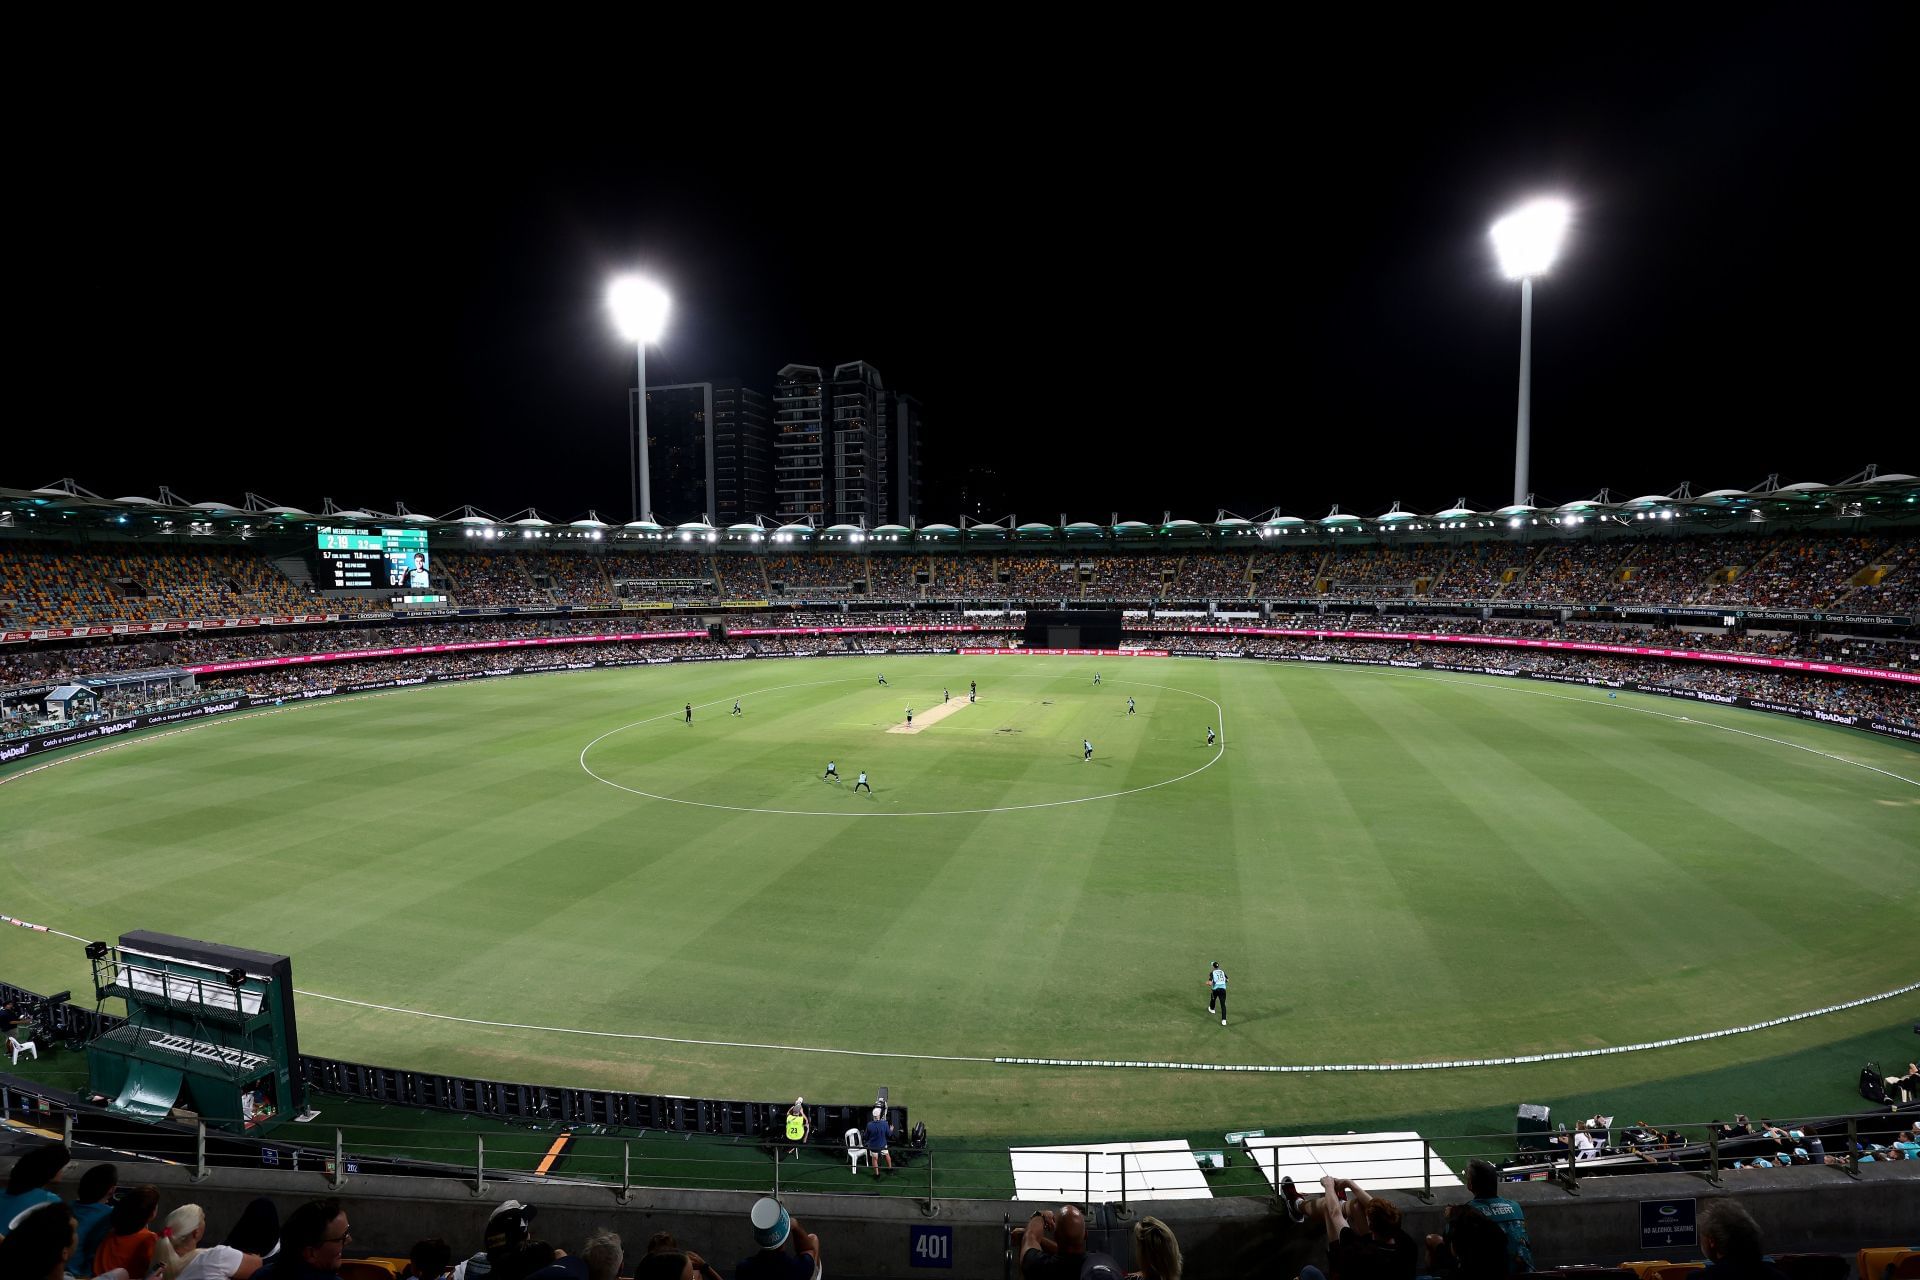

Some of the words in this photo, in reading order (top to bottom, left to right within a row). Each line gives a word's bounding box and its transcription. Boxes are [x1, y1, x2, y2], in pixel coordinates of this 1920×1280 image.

[1485, 667, 1514, 676] TripADeal
[396, 678, 423, 686] TripADeal
[19, 687, 45, 697] Southern
[303, 689, 332, 698] TripADeal
[1697, 692, 1732, 703] TripADeal
[204, 703, 233, 714] TripADeal
[1771, 704, 1787, 712] travel
[1814, 710, 1852, 725] TripADeal
[43, 739, 57, 747] Catch
[63, 734, 76, 743] travel
[100, 720, 132, 736] TripADeal
[1871, 722, 1886, 731] Catch
[1893, 727, 1909, 736] travel
[347, 1164, 358, 1172] 202
[1492, 1206, 1515, 1215] HEAT
[916, 1234, 947, 1259] 401
